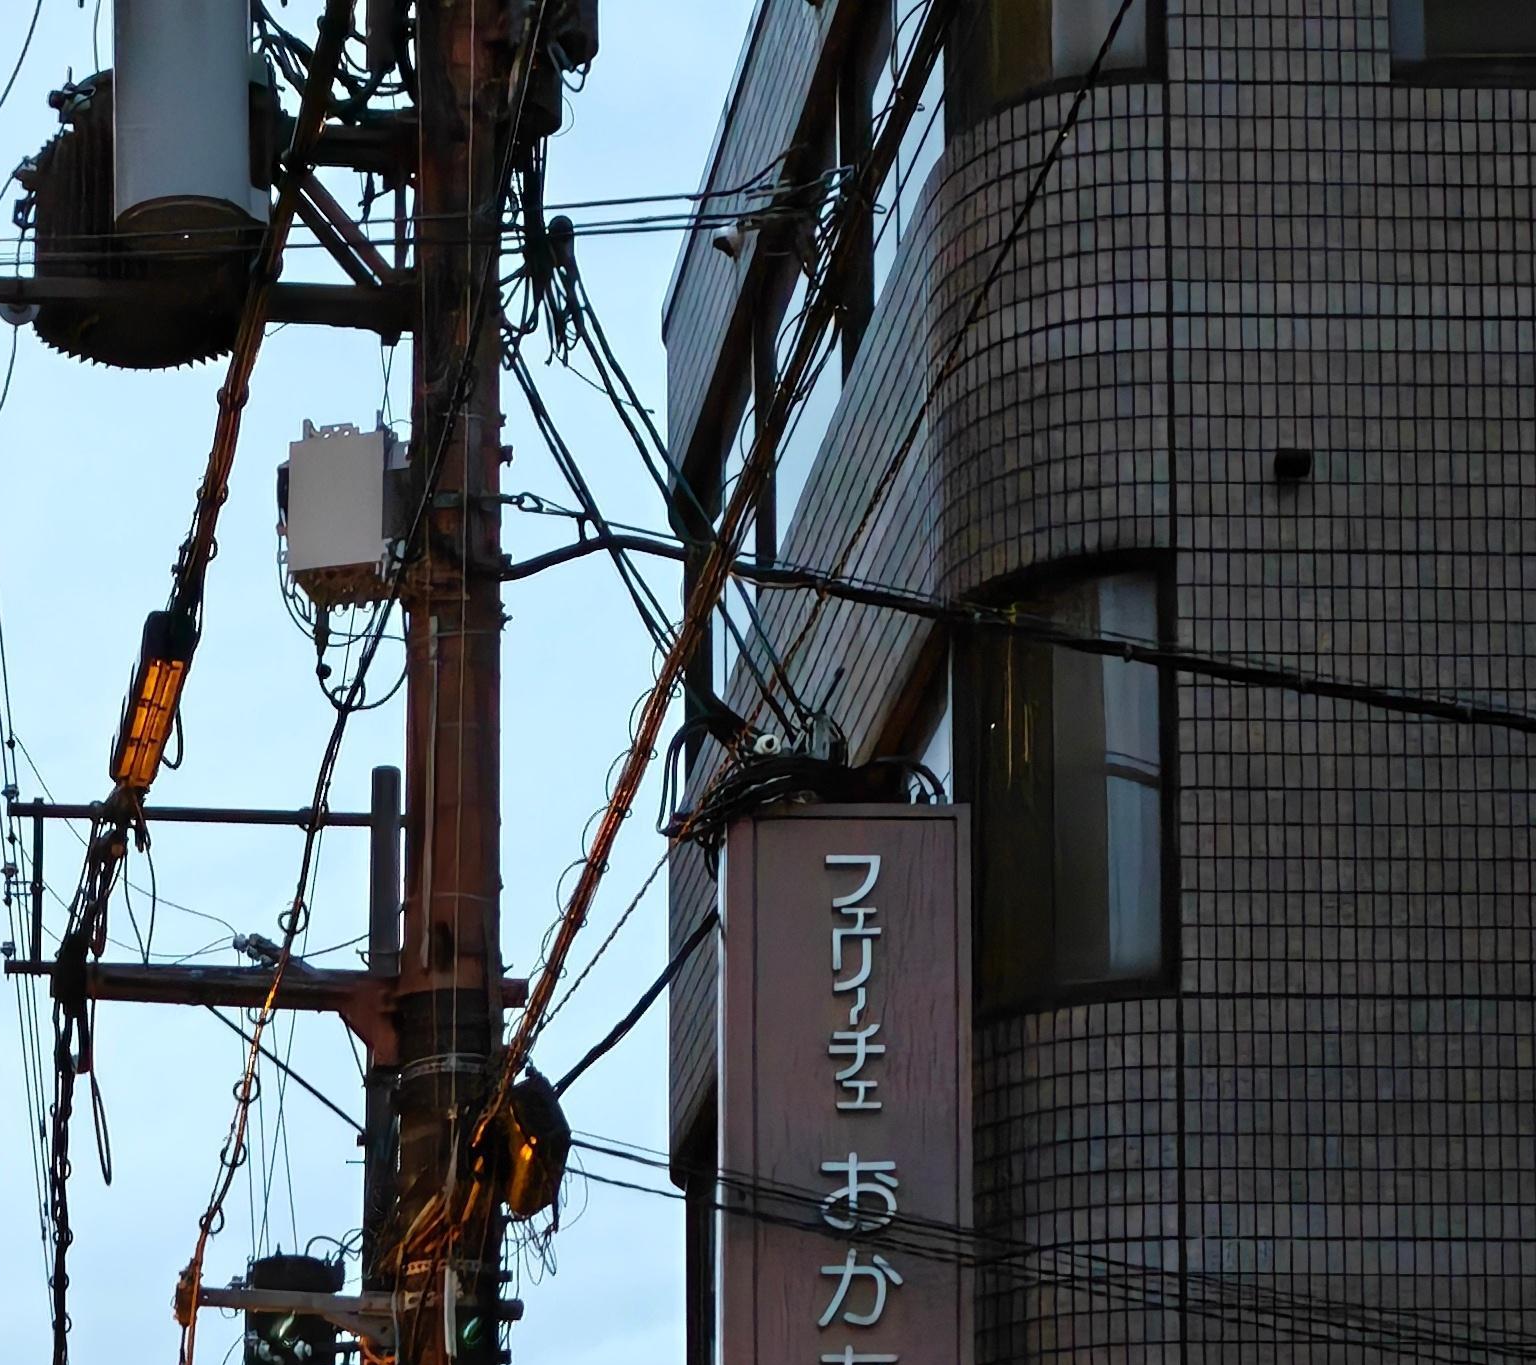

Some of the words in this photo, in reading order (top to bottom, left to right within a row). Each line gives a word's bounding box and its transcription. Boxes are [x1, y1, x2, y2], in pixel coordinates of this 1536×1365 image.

[825, 853, 887, 1110] フェリーチェ
